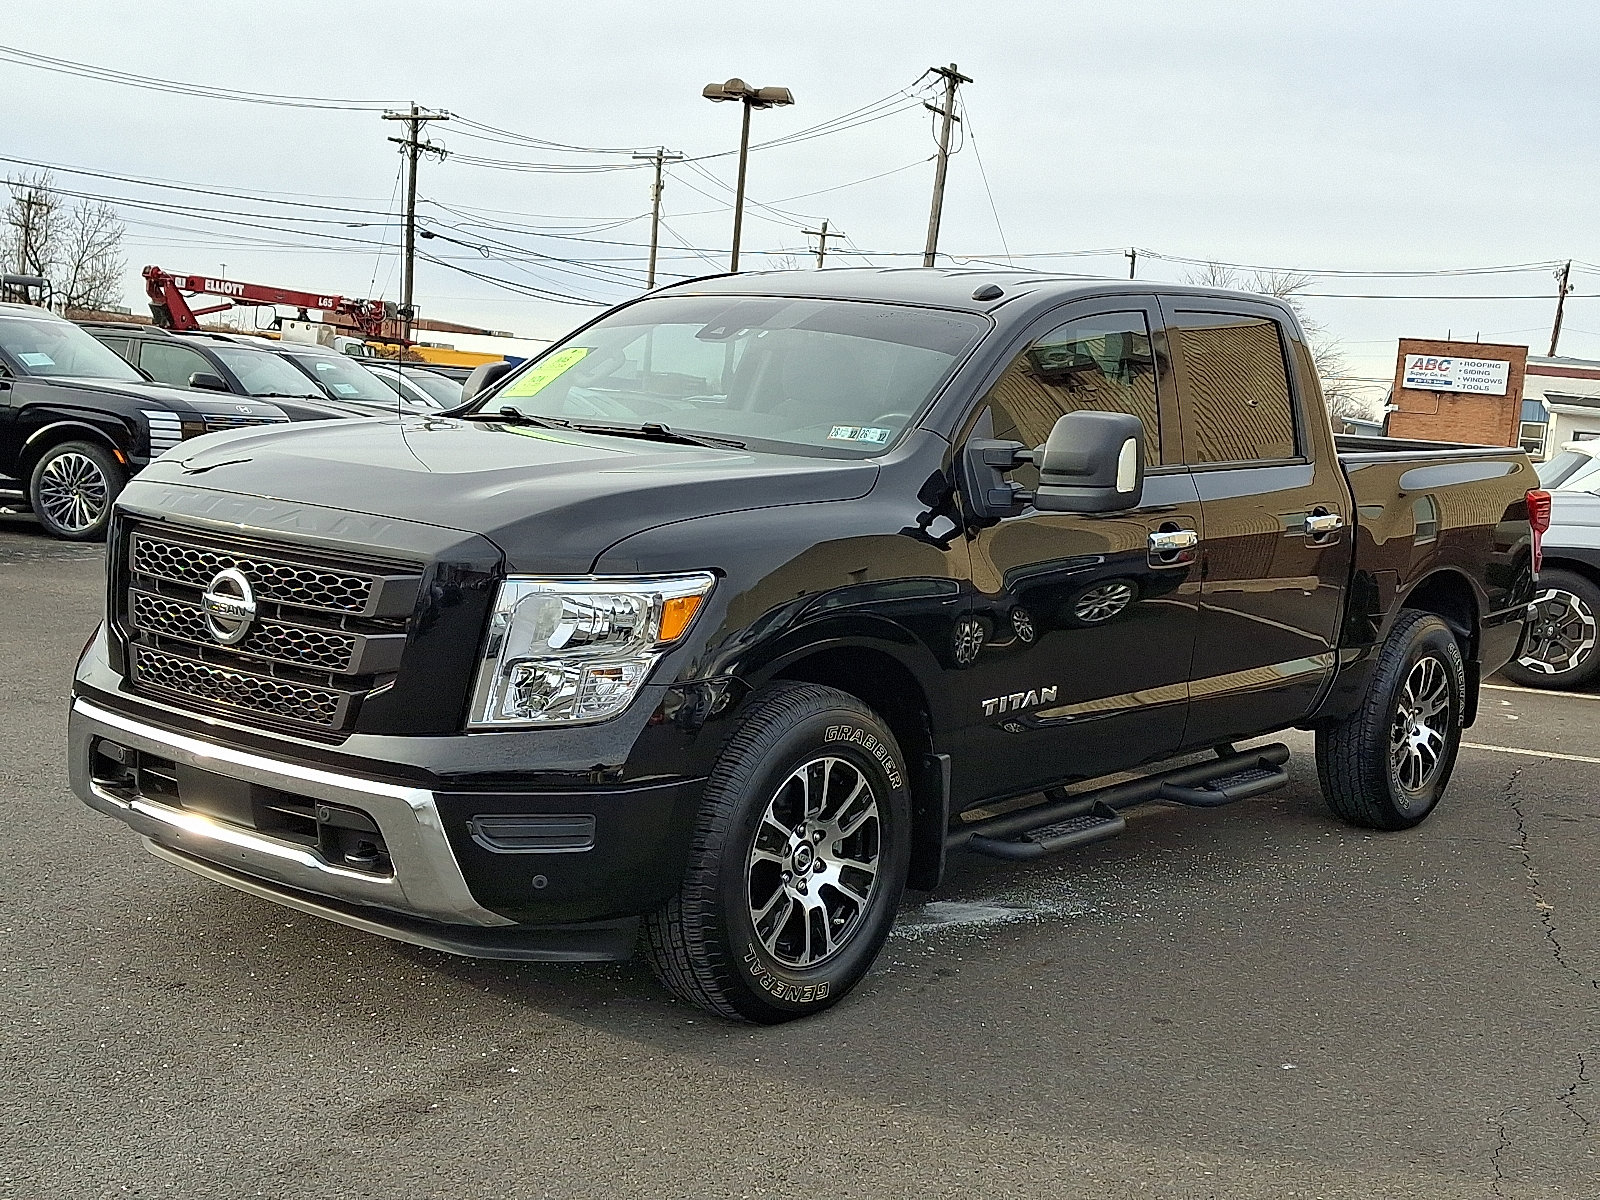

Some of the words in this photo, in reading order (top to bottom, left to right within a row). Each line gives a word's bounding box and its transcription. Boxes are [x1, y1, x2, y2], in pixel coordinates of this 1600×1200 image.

[205, 279, 244, 295] ELLIOTT
[318, 296, 333, 308] L65
[1408, 358, 1453, 371] ABC
[1464, 361, 1501, 369] ROOFING
[1462, 376, 1502, 384] WINDOWS
[1462, 383, 1489, 391] TOOLS
[158, 487, 394, 540] TITAN
[981, 685, 1058, 717] TITAN
[824, 725, 902, 789] GRABBER
[743, 943, 830, 1002] GENERAL
